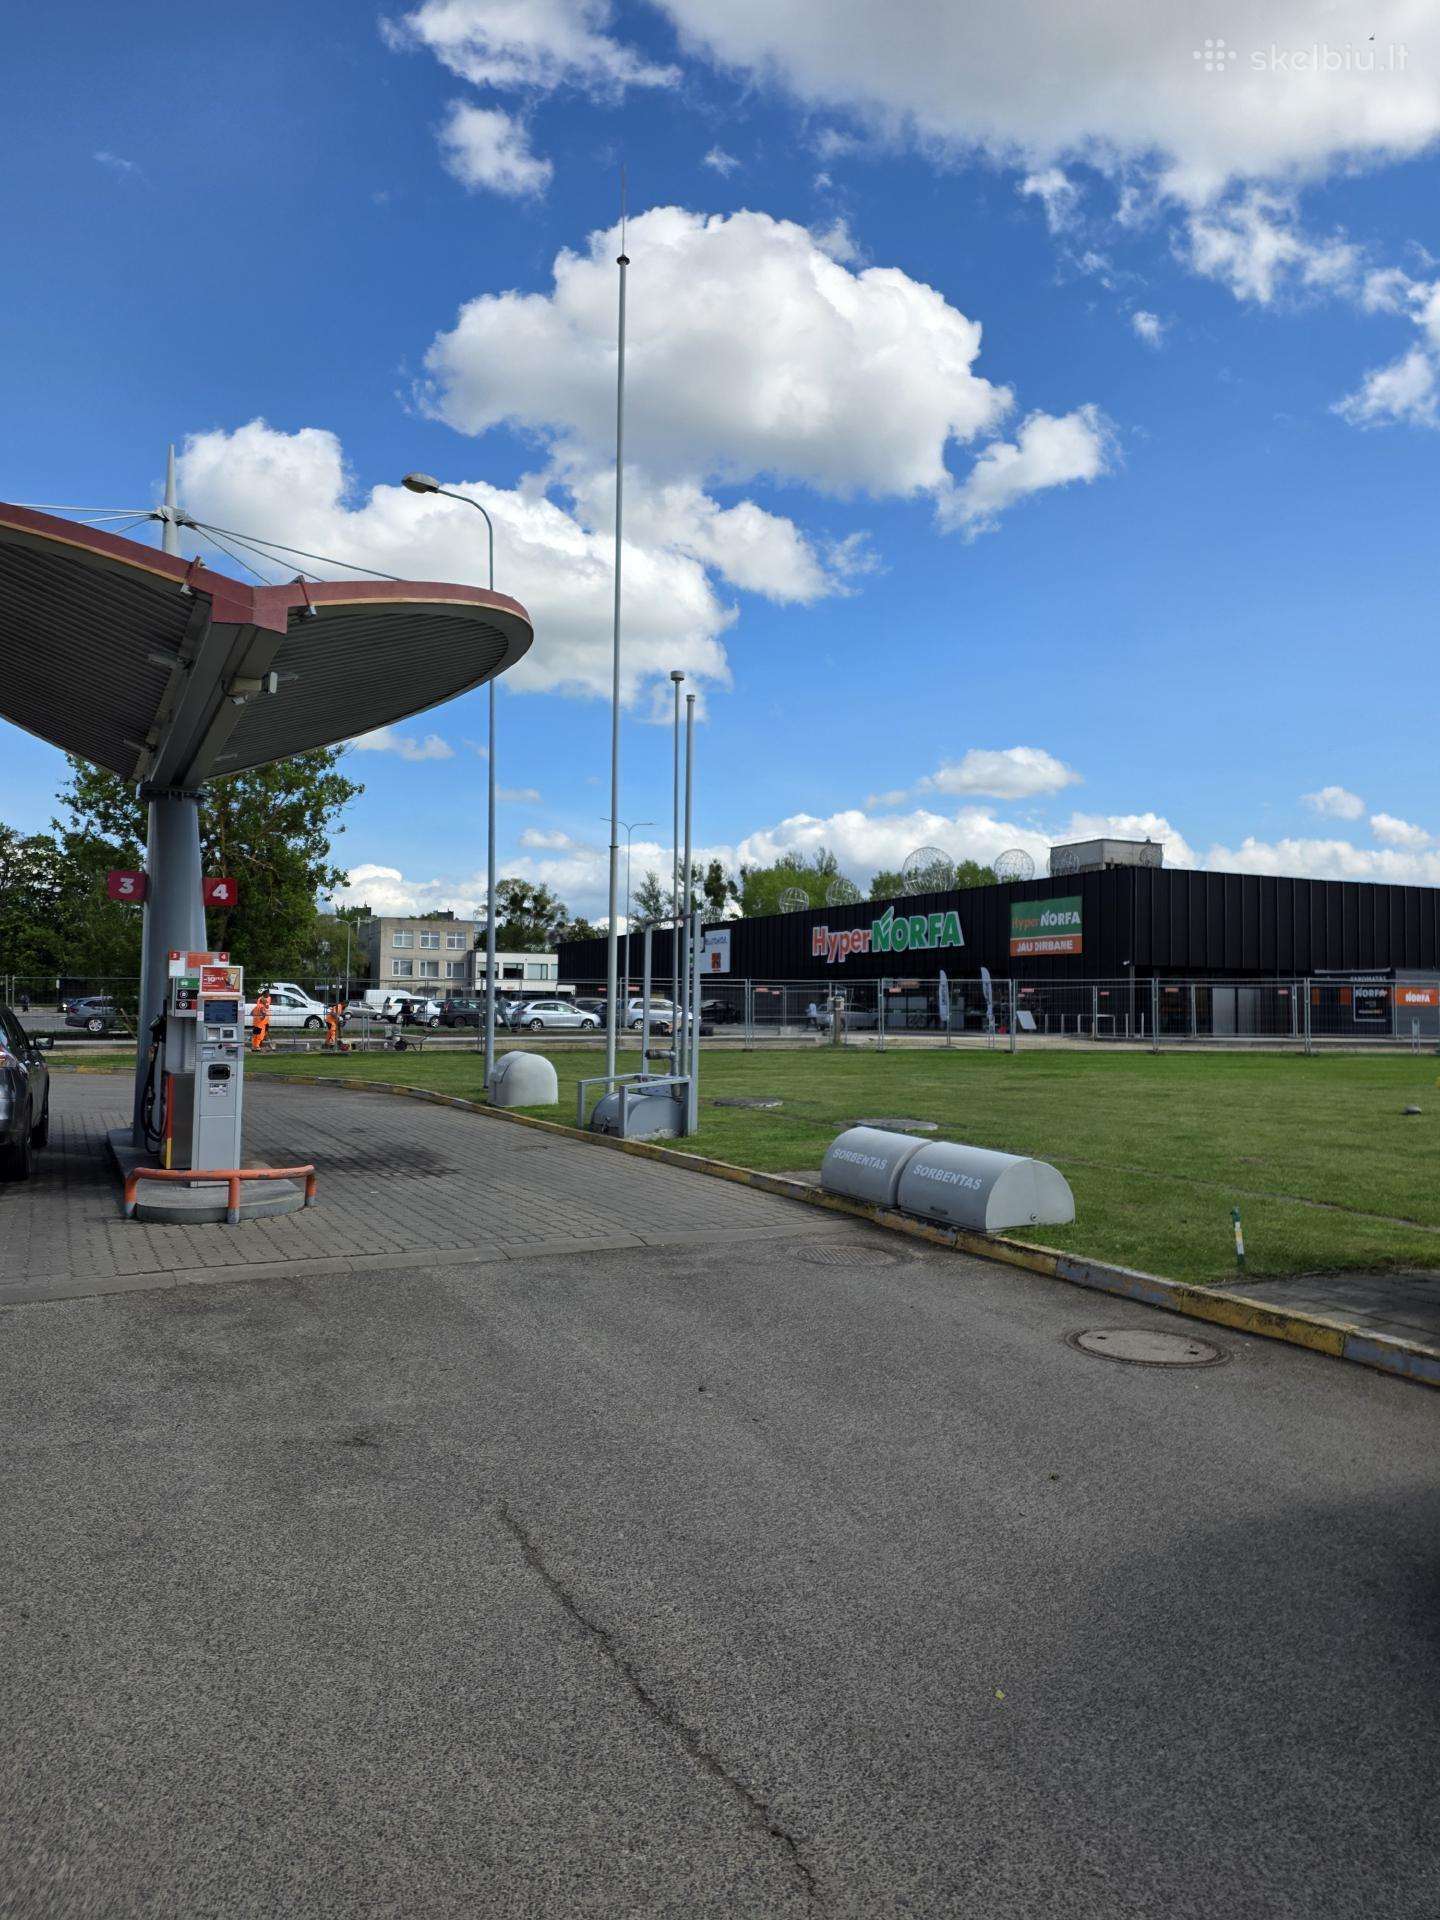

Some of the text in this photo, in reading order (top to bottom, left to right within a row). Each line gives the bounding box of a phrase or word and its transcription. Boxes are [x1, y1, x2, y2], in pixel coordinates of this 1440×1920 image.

[119, 877, 135, 894] 3
[212, 883, 229, 900] 4
[1017, 942, 1034, 953] JAU
[832, 1148, 888, 1170] SORBENTAS
[913, 1164, 983, 1190] SORBENTAS
